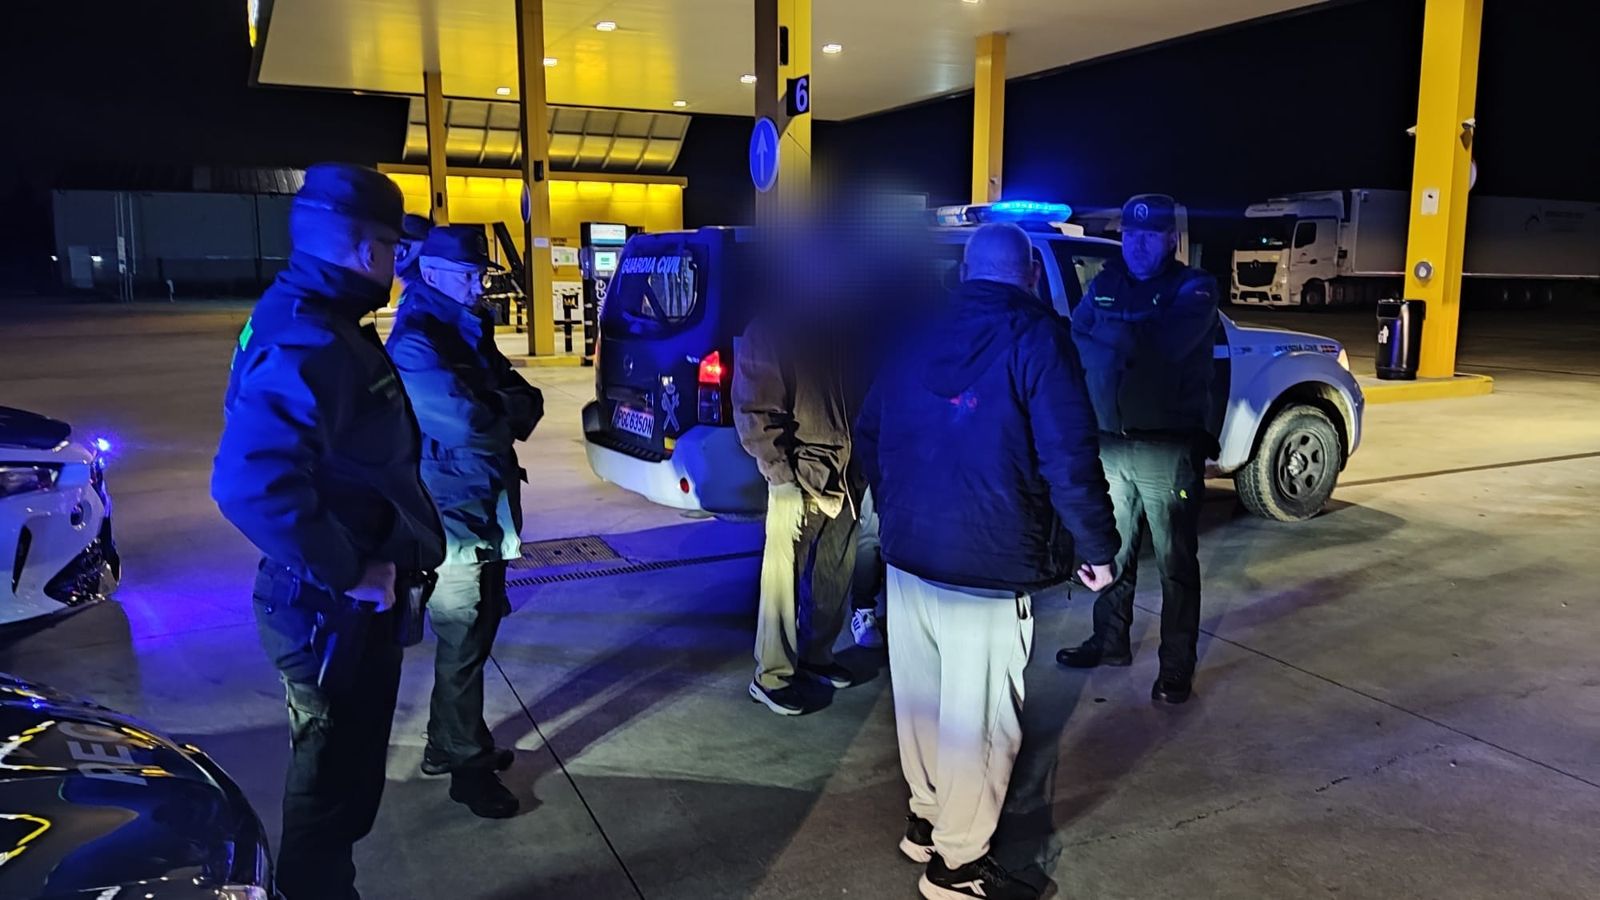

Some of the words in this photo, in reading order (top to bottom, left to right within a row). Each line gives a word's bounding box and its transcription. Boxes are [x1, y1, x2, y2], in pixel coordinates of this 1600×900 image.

[796, 78, 808, 112] 6
[621, 256, 656, 274] GUARDIA
[657, 256, 681, 274] CIVIL
